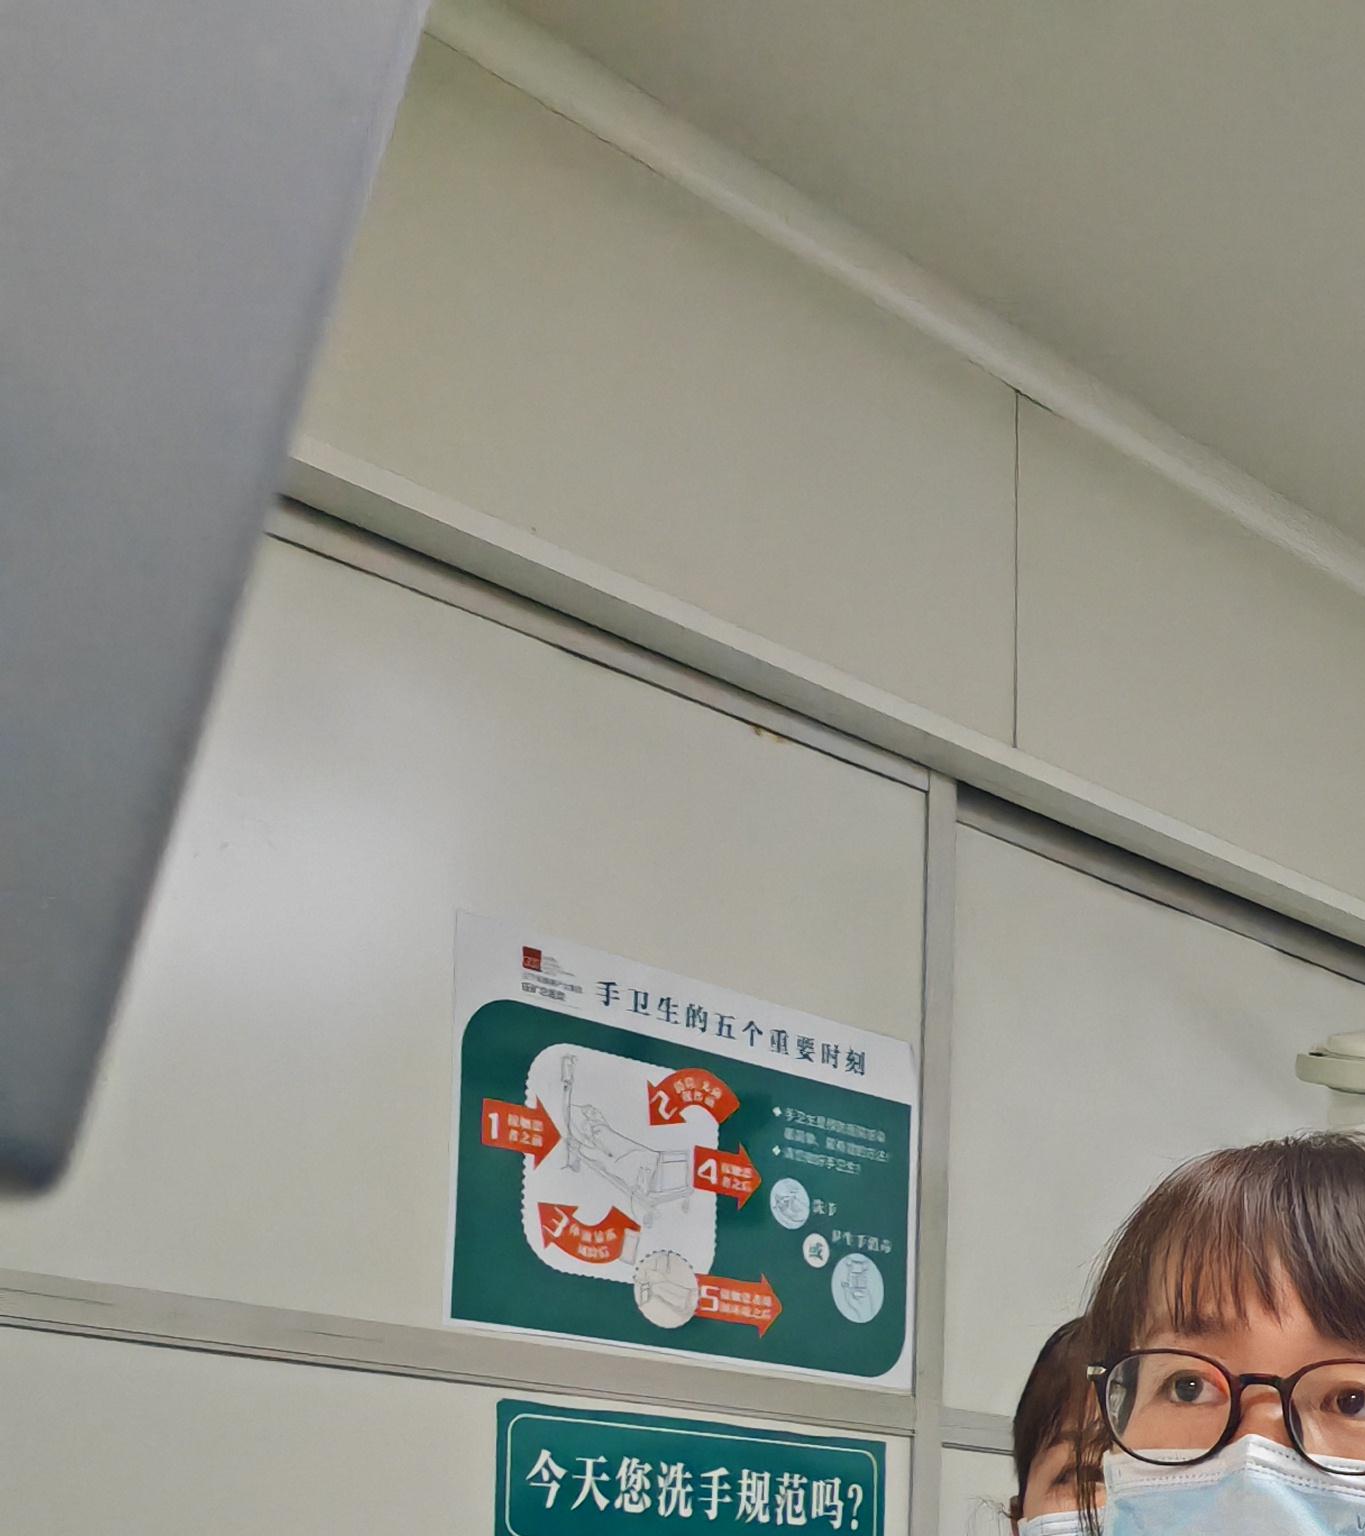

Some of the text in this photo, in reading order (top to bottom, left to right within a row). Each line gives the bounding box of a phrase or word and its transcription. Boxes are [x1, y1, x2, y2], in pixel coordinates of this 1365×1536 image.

[596, 981, 867, 1077] 手卫生的五个重要时刻
[649, 1089, 678, 1120] 2
[488, 1112, 499, 1140] 1
[697, 1158, 718, 1185] 4
[543, 1206, 570, 1238] 3
[700, 1285, 720, 1312] 5
[525, 1449, 863, 1530] 今天您洗手规范吗?
